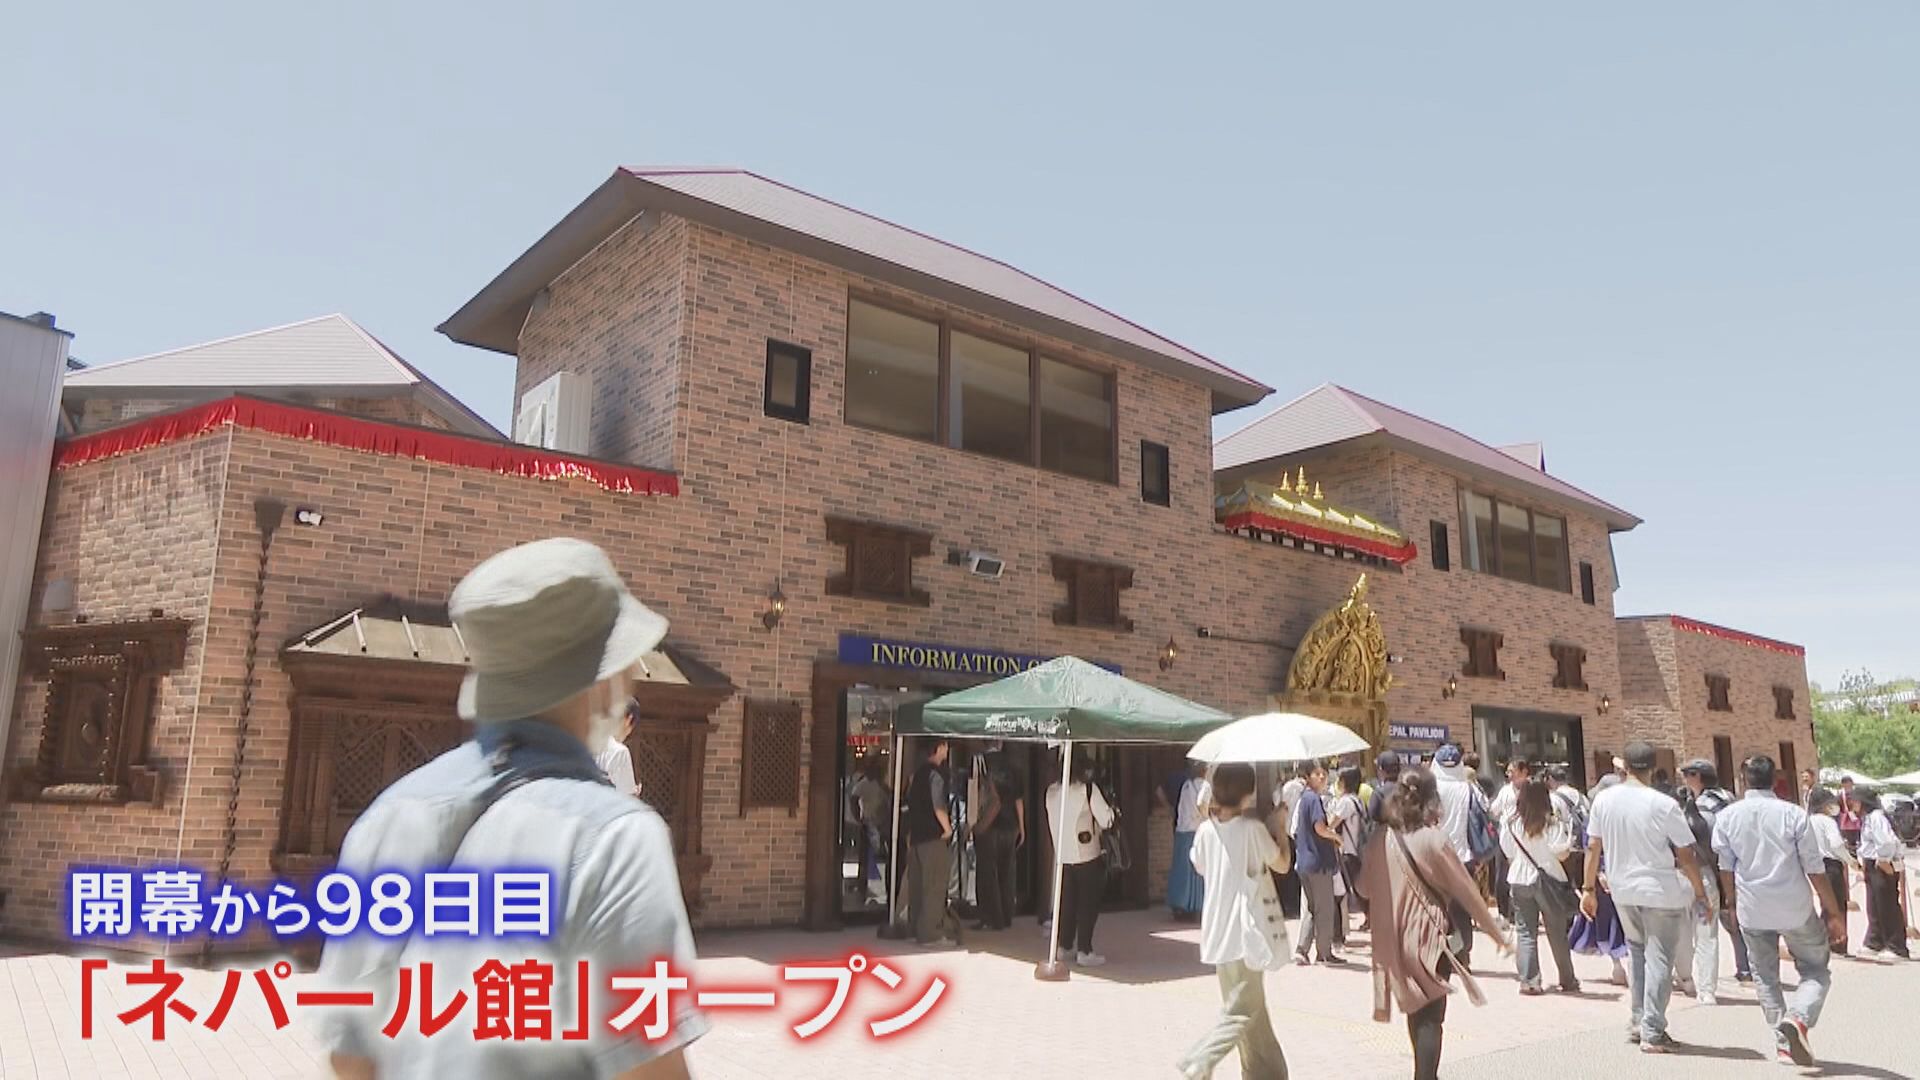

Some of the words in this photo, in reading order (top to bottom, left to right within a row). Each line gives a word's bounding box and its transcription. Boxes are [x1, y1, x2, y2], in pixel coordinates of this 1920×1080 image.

[872, 642, 1020, 674] INFORMATION
[1389, 725, 1407, 737] EPAL
[1409, 726, 1445, 739] PAVILION
